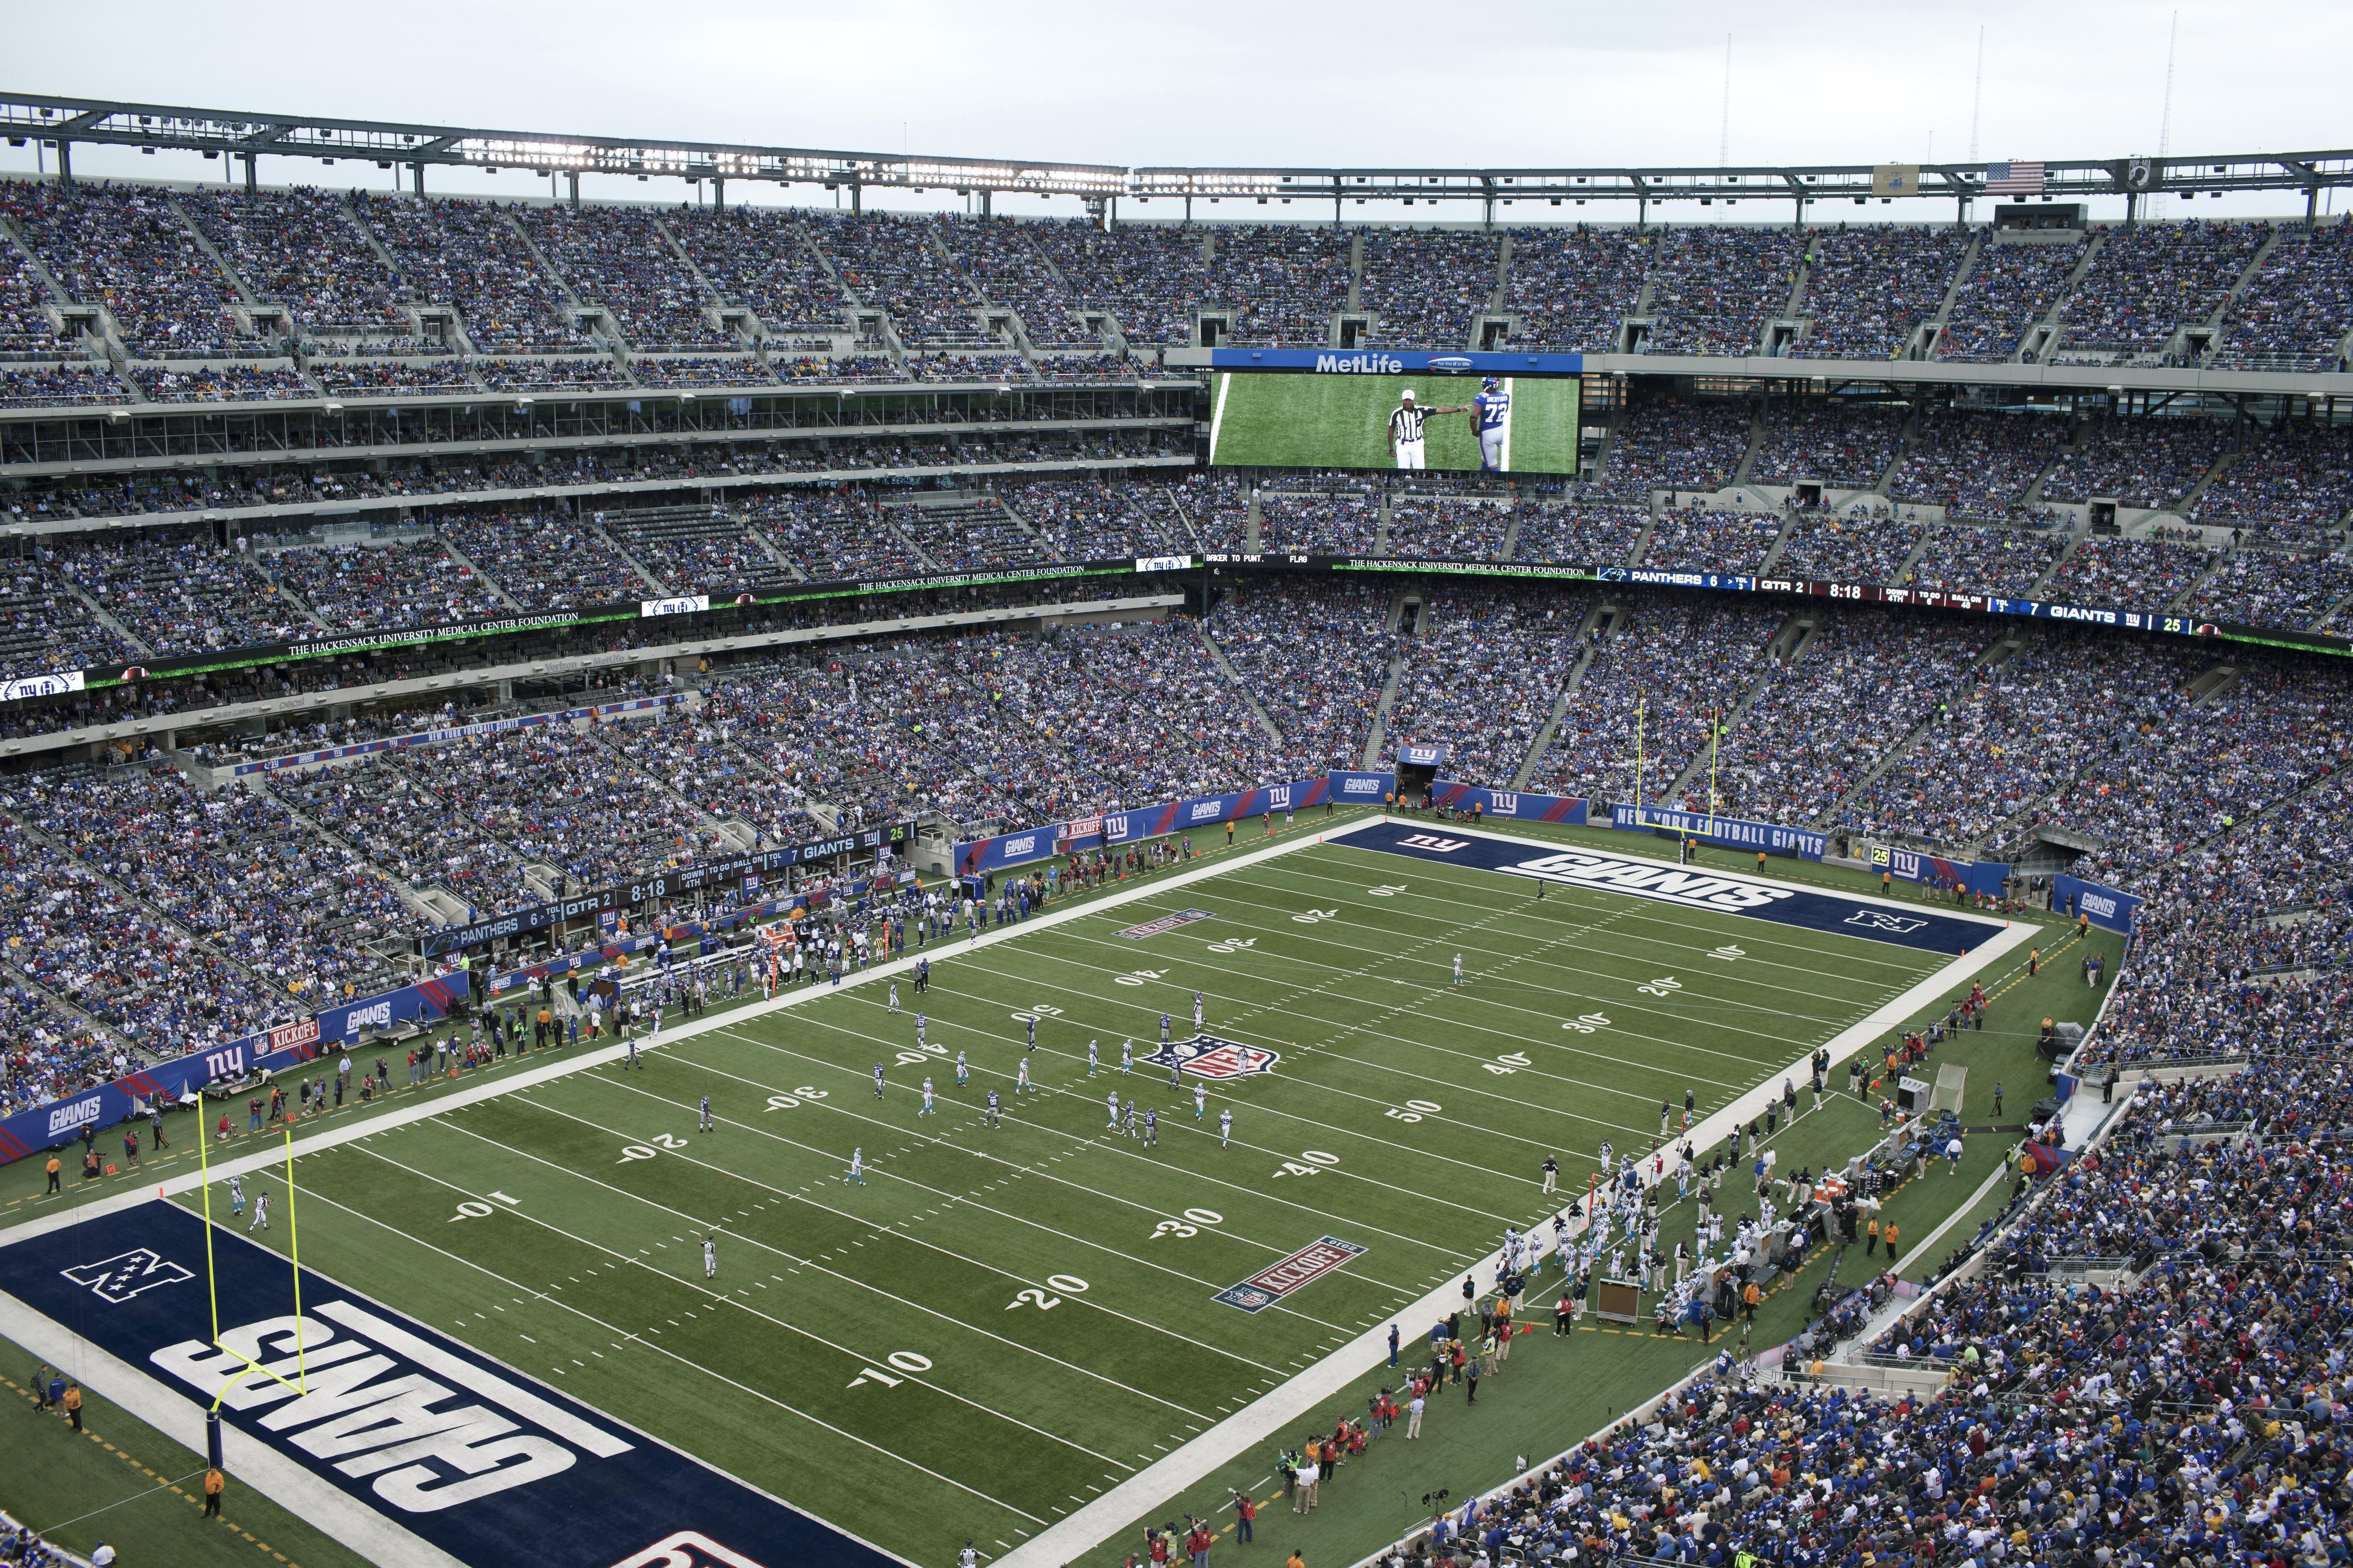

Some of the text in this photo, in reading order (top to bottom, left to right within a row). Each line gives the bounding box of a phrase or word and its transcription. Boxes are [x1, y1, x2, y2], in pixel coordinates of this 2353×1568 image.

[1316, 353, 1402, 373] MetLife
[1485, 403, 1507, 422] 72
[1206, 554, 1228, 562] BAKER
[1367, 560, 1417, 569] HACKENSACK
[1419, 562, 1464, 570] UNIVERSITY
[1465, 564, 1500, 572] MEDICAL
[1501, 565, 1532, 573] CENTER
[1533, 566, 1585, 576] FOUNDATION
[858, 565, 1084, 591] THE HACKENSACK UNIVERSITY MEDICAL CENTER FOUNDATION
[1632, 571, 1718, 587] PANTHERS 6
[1761, 580, 1803, 593] QTR 2
[1830, 584, 1861, 599] 8:18
[1951, 594, 1970, 602] BALL
[2031, 603, 2116, 623] 7 GIANTS
[2164, 618, 2180, 632] 25
[289, 612, 578, 656] THE HACKENSACK UNIVERSITY MEDICAL CENTER FOUNDATION
[545, 660, 577, 672] Verizon
[593, 653, 625, 665] MetLife
[279, 696, 305, 711] pepsi
[597, 706, 606, 714] ny
[623, 701, 637, 710] GIANTS
[652, 698, 660, 706] ny
[429, 719, 519, 741] NEW YORK FOOTBALL GIANTS
[389, 738, 398, 747] ny
[298, 753, 315, 761] GIANTS
[334, 749, 343, 757] ny
[1409, 748, 1437, 760] ny
[1343, 778, 1379, 793] GIANTS
[1269, 786, 1290, 809] ny
[1491, 792, 1517, 815] ny
[1191, 800, 1221, 819] GIANTS
[890, 827, 904, 841] 25
[1071, 819, 1100, 835] KICKOFF
[1106, 816, 1128, 840] ny
[1618, 808, 1823, 856] NEW YORK FOOTBALL GIANTS
[864, 832, 878, 847] ny
[1004, 836, 1035, 856] GIANTS
[1396, 834, 1472, 852] ny
[769, 852, 782, 861] TOL
[791, 837, 855, 861] 7 GIANTS
[879, 846, 891, 859] ny
[1872, 849, 1888, 863] 25
[709, 863, 730, 874] TO GO
[734, 855, 763, 869] BALL ON
[744, 865, 753, 874] 48
[773, 860, 778, 868] 3
[1893, 851, 1920, 879] ny
[681, 869, 704, 881] DOWN
[685, 877, 700, 888] 4TH
[718, 872, 723, 881] 6
[745, 875, 758, 890] ny
[1516, 854, 1795, 907] GIANTS
[632, 880, 665, 902] 8:18
[1368, 885, 1405, 896] 10
[546, 905, 560, 916] TOL
[566, 893, 610, 916] QTR 2
[775, 899, 794, 913] GIANTS
[2081, 891, 2117, 918] GIANTS
[551, 915, 556, 923] 3
[602, 911, 615, 926] ny
[1292, 909, 1336, 923] 20
[460, 913, 538, 944] PANTHERS 6
[1127, 915, 1188, 937] KICKOFF
[635, 935, 655, 950] GIANTS
[1207, 938, 1254, 953] 30
[1706, 946, 1746, 962] 10
[569, 956, 582, 969] ny
[490, 976, 512, 992] GIANTS
[1114, 970, 1161, 986] 40
[1637, 978, 1682, 997] 20
[347, 1001, 390, 1034] GIANTS
[1011, 1004, 1064, 1022] 50
[1562, 1013, 1611, 1033] 30
[273, 1021, 316, 1048] KICKOFF
[896, 1043, 949, 1064] 40
[206, 1046, 244, 1078] ny
[1179, 1048, 1268, 1077] NFL
[1481, 1053, 1532, 1075] 40
[768, 1085, 829, 1109] 30
[48, 1096, 101, 1136] GIANTS
[1384, 1099, 1442, 1123] 50
[621, 1133, 688, 1160] 20
[1284, 1150, 1340, 1176] 40
[457, 1191, 522, 1217] 10
[1155, 1208, 1224, 1238] 30
[1328, 1239, 1358, 1251] 2010
[1257, 1247, 1342, 1291] KICKOFF
[1017, 1274, 1089, 1310] 20
[859, 1351, 932, 1388] 10
[149, 1314, 577, 1513] GIANTS
